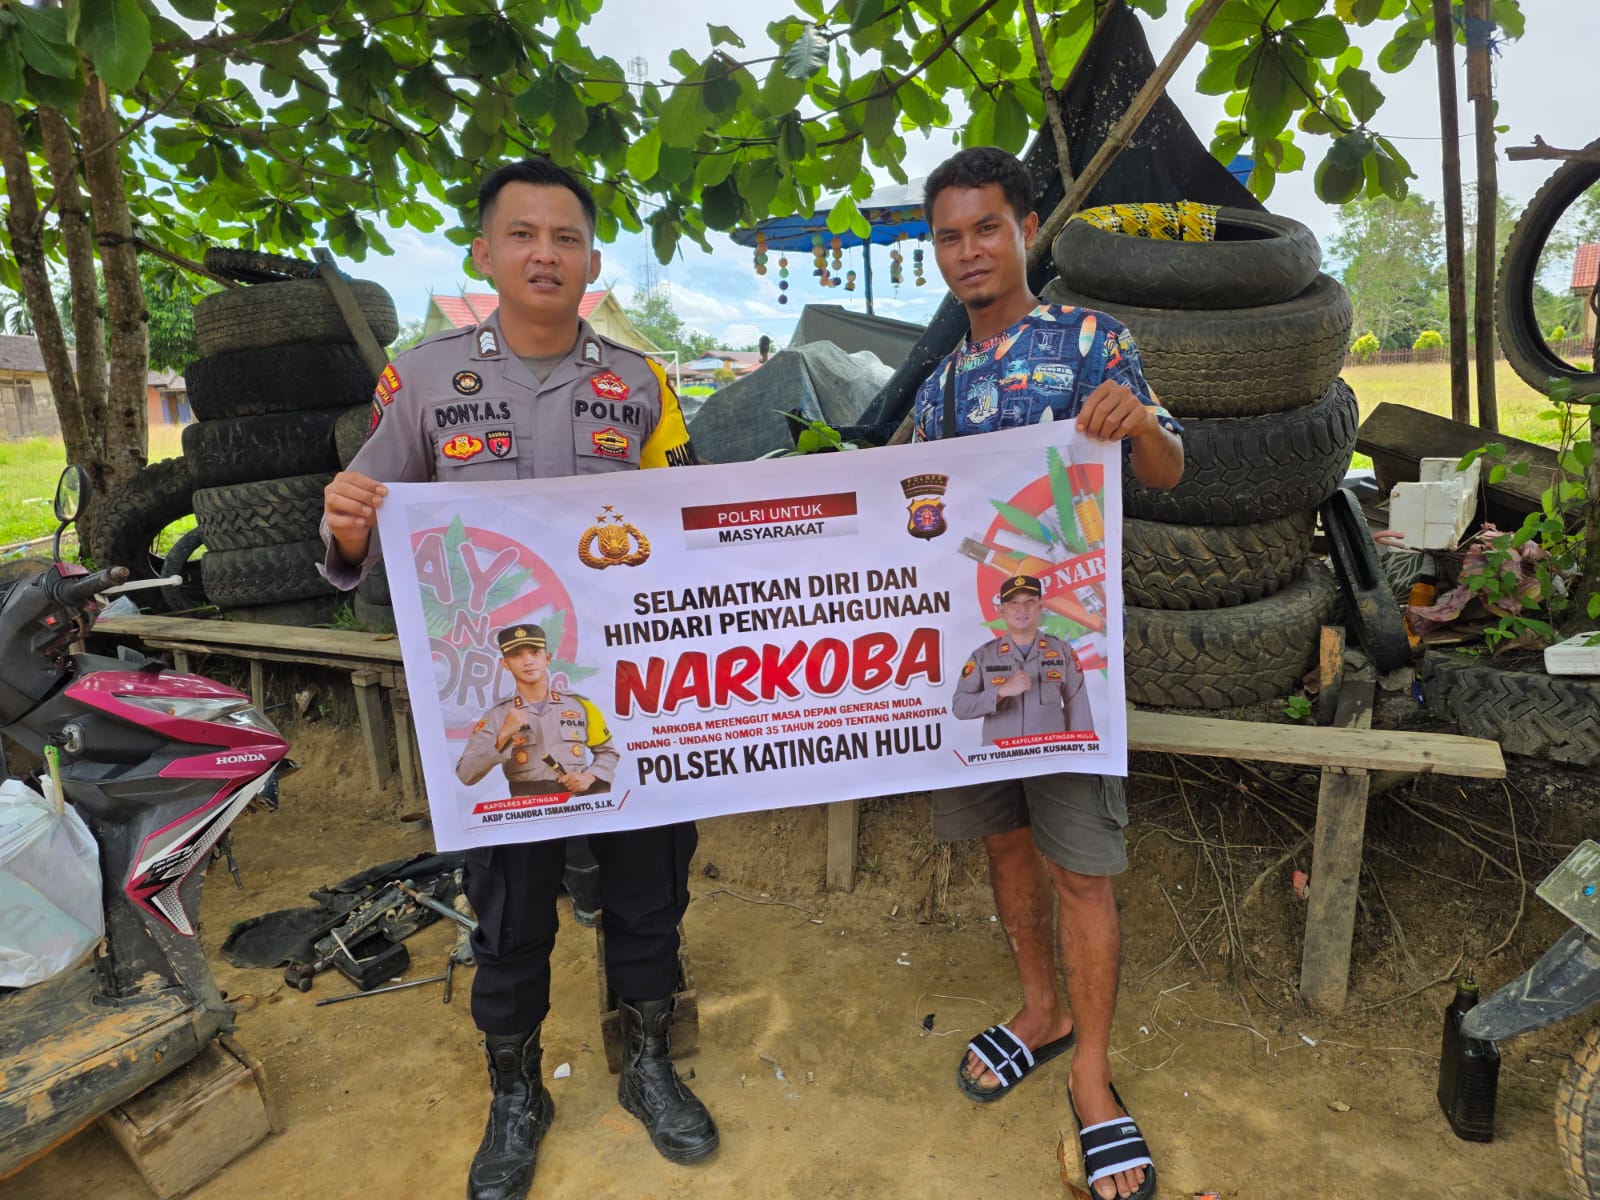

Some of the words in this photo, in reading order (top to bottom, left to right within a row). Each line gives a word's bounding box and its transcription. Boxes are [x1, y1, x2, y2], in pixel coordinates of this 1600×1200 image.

[435, 402, 511, 428] DONY.A.S
[575, 400, 640, 425] POLRI
[718, 509, 765, 524] POLRI
[769, 503, 823, 520] UNTUK
[718, 521, 825, 543] MASYARAKAT
[633, 576, 800, 616] SELAMATKAN
[808, 571, 858, 598] DIRI
[866, 566, 918, 593] DAN
[604, 614, 712, 647] HINDARI
[719, 590, 950, 634] PENYALAHGUNAAN
[614, 627, 942, 717] NARKOBA
[560, 719, 585, 728] POLRI
[652, 721, 703, 735] NARKOBA
[705, 713, 769, 729] MERENGGUT
[772, 709, 801, 721] MASA
[803, 706, 837, 718] DEPAN
[839, 701, 889, 714] GENERASI
[892, 697, 922, 709] MUDA
[627, 738, 671, 751] UNDANG
[679, 733, 722, 746] UNDANG
[725, 728, 763, 741] NOMOR
[766, 725, 779, 736] 35
[781, 719, 814, 733] TAHUN
[817, 718, 843, 729] 2009
[845, 713, 890, 726] TENTANG
[892, 706, 947, 721] NARKOTIKA
[1012, 736, 1043, 745] KAPOLSEK
[1044, 733, 1075, 742] KATINGAN
[215, 753, 267, 765] HONDA
[637, 747, 739, 786] POLSEK
[743, 732, 868, 774] KATINGAN
[875, 723, 942, 757] HULU
[968, 753, 987, 763] IPTU
[989, 746, 1042, 759] YUBAMBANG
[1043, 743, 1085, 754] KUSNADY,
[1087, 743, 1100, 751] SH
[482, 813, 503, 823] AKBP
[505, 808, 543, 820] CHANDRA
[544, 803, 593, 816] ISMAWANTO,
[595, 799, 615, 809] S.I.K.
[483, 800, 521, 810] KAPOLRES
[522, 796, 559, 805] KATINGAN
